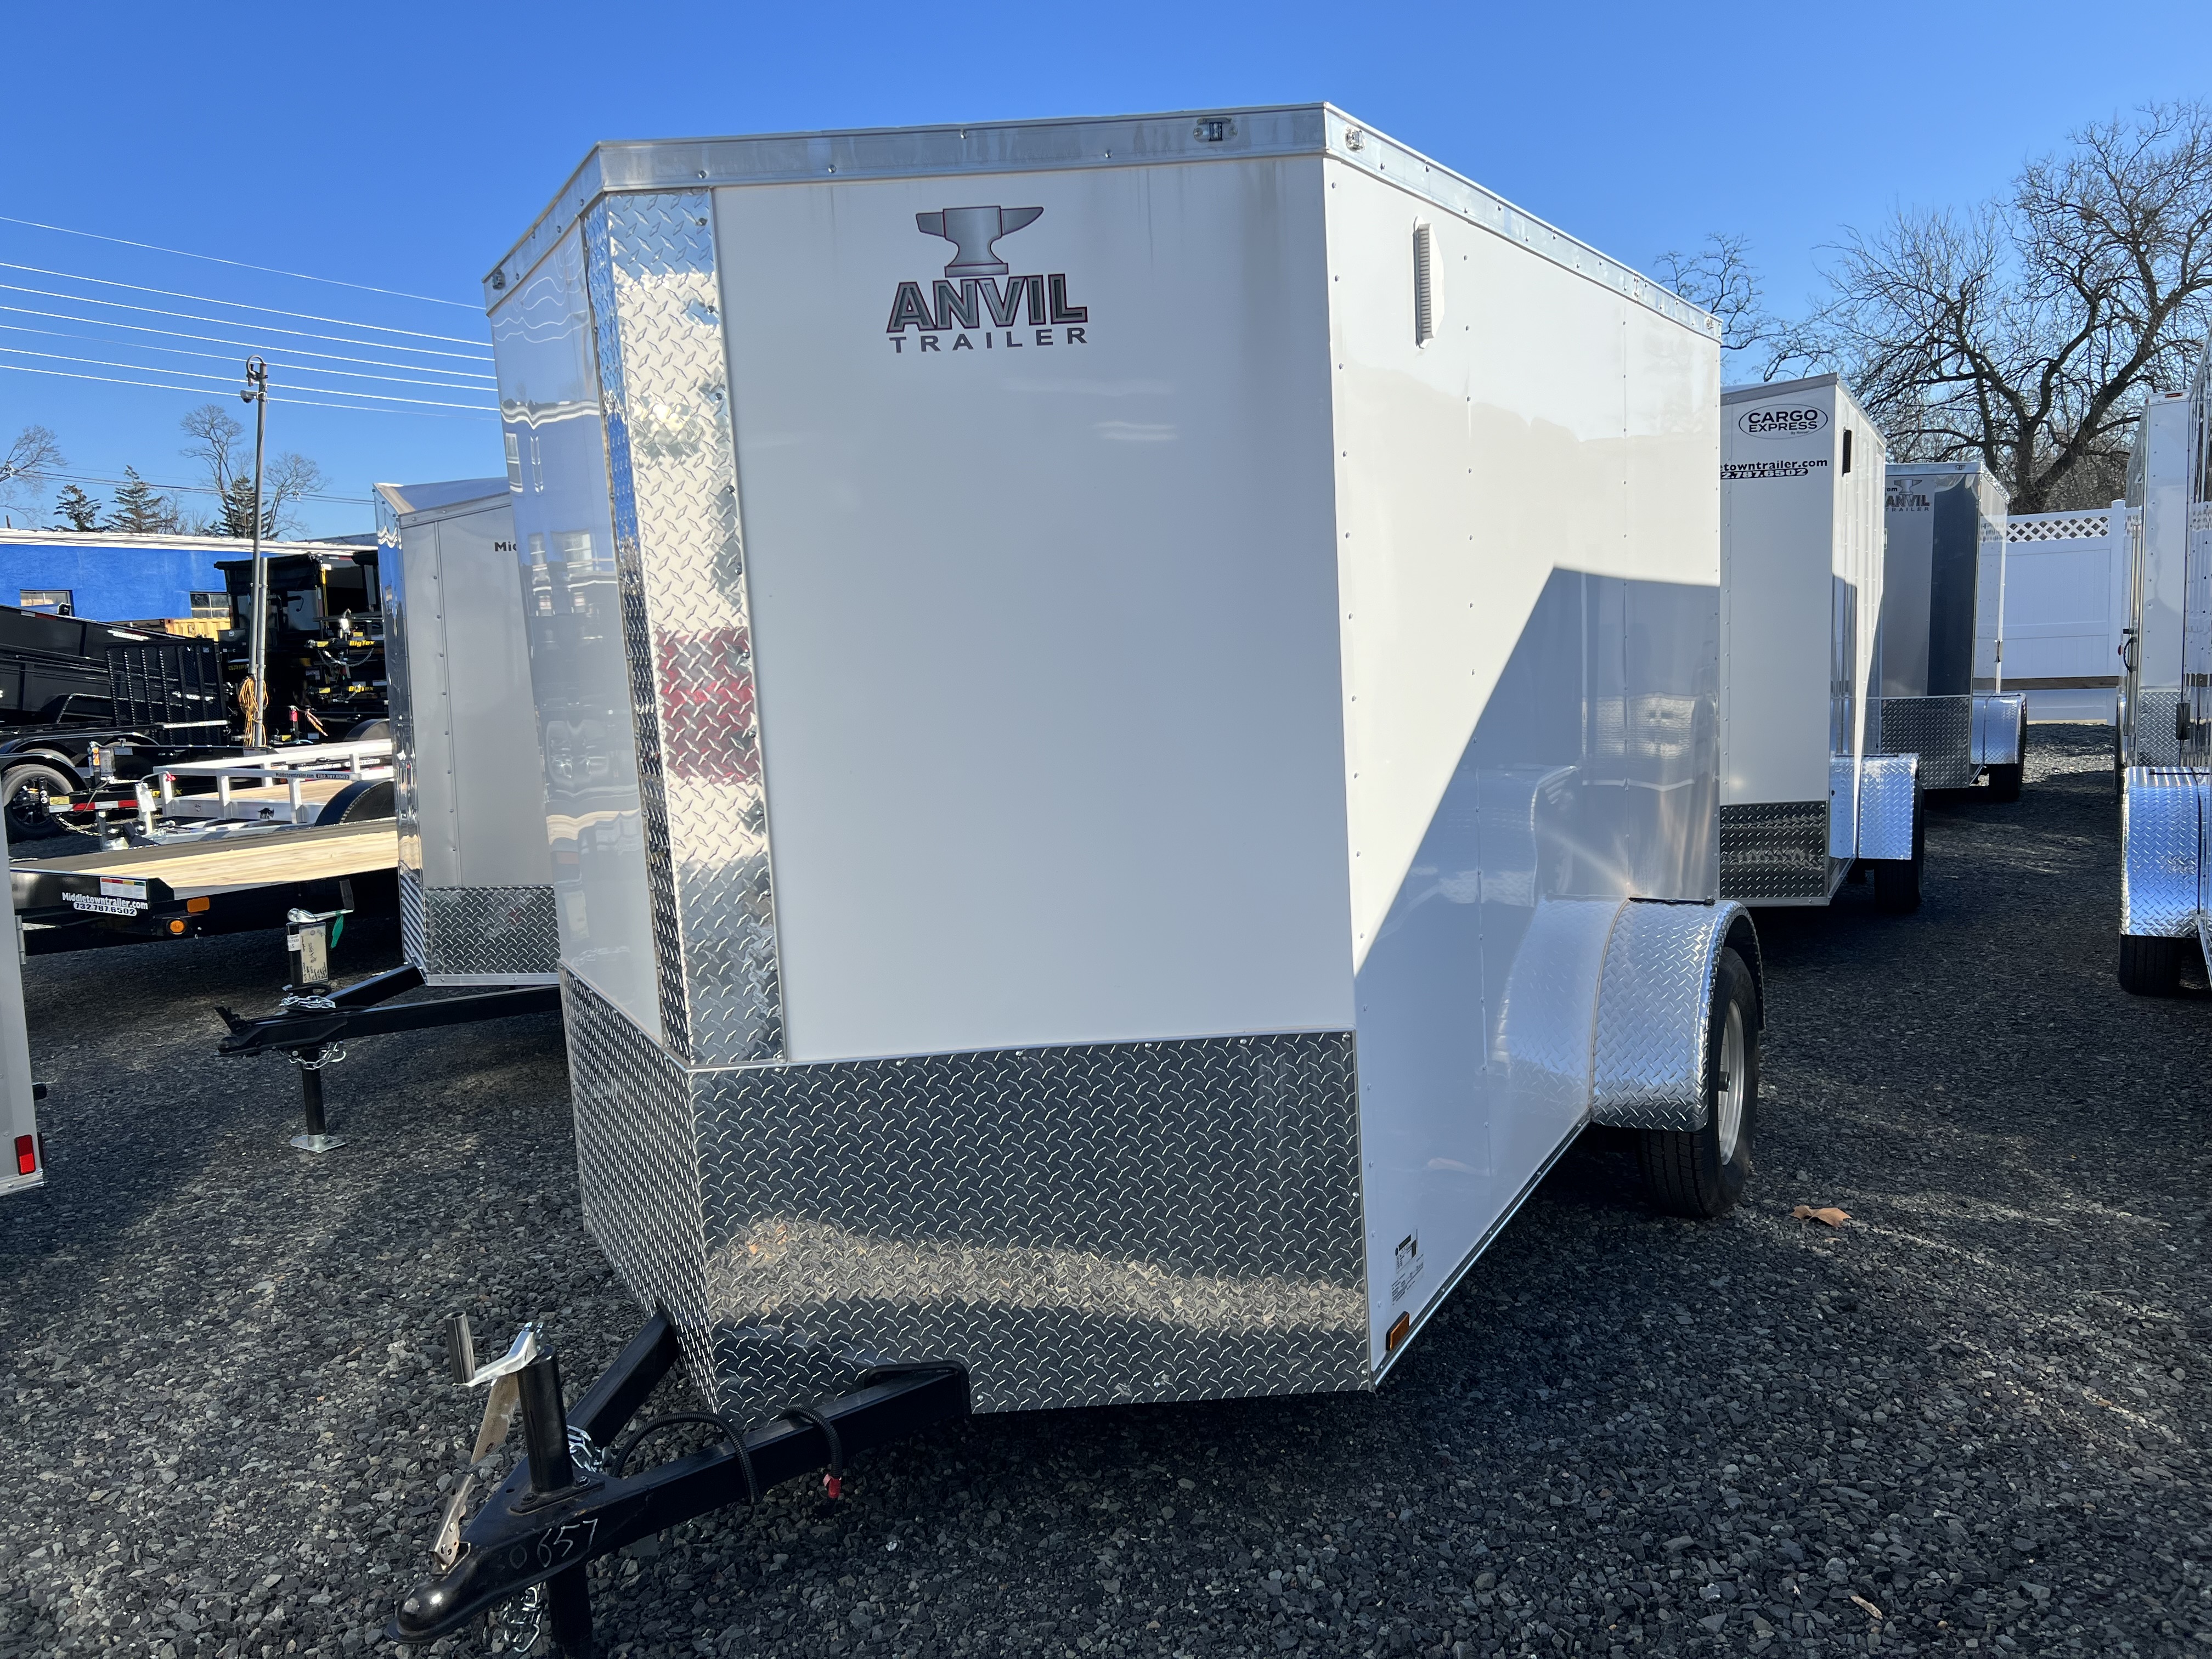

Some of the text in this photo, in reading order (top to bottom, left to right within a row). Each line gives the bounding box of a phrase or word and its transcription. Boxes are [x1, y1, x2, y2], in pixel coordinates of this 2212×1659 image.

[886, 273, 1088, 333] ANVIL
[889, 328, 1088, 354] TRAILER
[1748, 410, 1818, 424] CARGO
[1749, 421, 1817, 432] EXPRESS
[1885, 495, 1930, 507] ANVIL
[62, 892, 148, 910] Middletowntrailer.com
[75, 902, 136, 915] 732.787.6502
